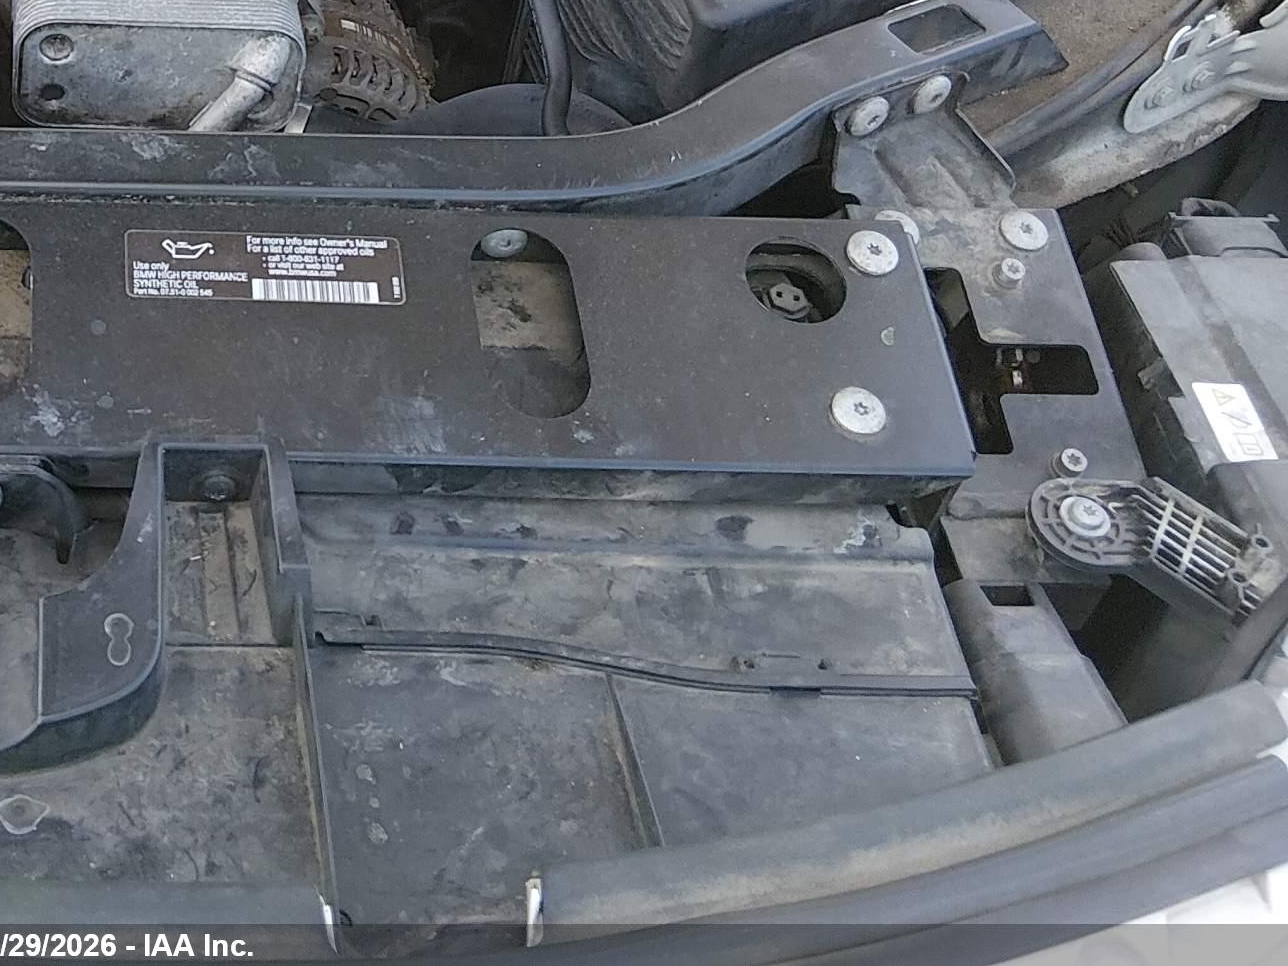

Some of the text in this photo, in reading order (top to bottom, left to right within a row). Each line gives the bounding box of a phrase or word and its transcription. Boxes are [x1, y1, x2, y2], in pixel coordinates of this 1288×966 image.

[246, 236, 261, 245] For
[262, 237, 285, 246] more
[286, 237, 302, 246] info
[319, 238, 354, 248] Owner's
[355, 239, 388, 249] Manual
[246, 244, 262, 253] For
[270, 245, 283, 254] list
[294, 246, 316, 255] other
[318, 246, 358, 257] approved
[359, 248, 375, 257] oils
[132, 261, 170, 273] Use only
[133, 270, 249, 282] BMW HIGH PERFORMANCE
[133, 279, 200, 289] SYNTHETIC OIL
